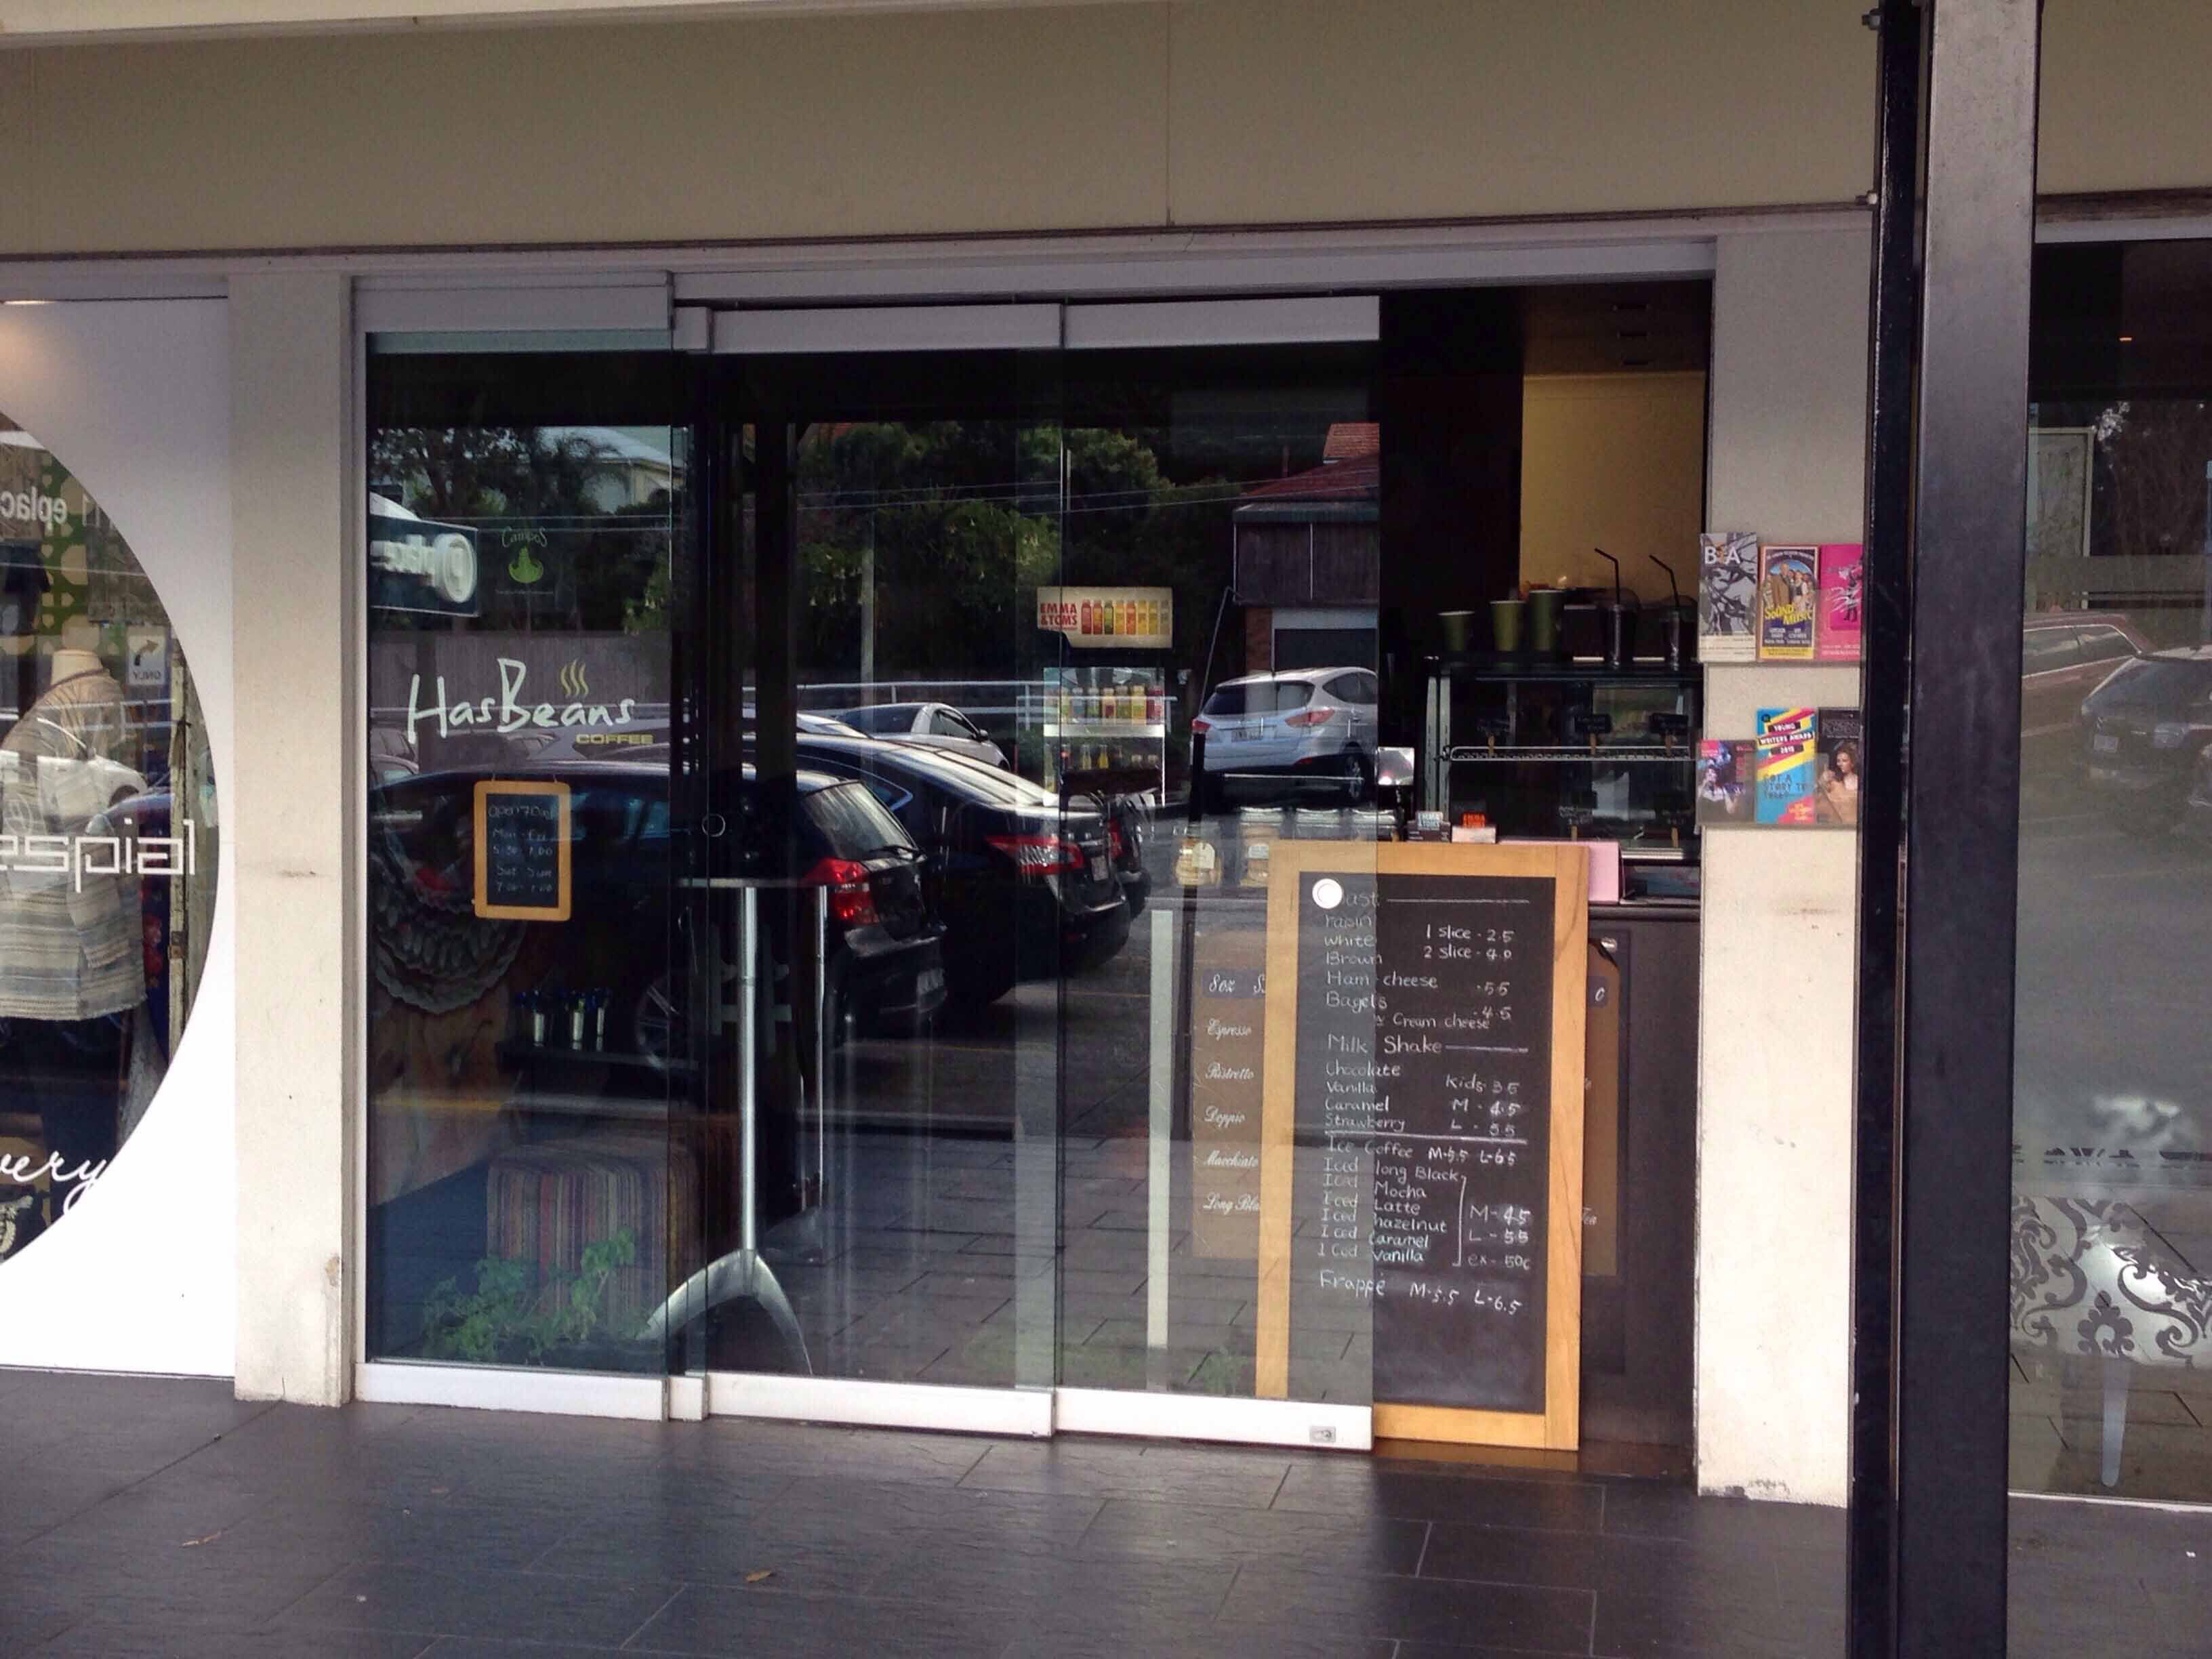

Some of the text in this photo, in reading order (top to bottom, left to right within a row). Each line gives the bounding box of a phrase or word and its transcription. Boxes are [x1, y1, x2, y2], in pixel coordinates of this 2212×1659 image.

[1040, 602, 1077, 613] EMMA
[575, 733, 654, 744] COFFEE
[1438, 924, 1472, 940] slice
[1424, 945, 1432, 958] 2
[1439, 943, 1472, 959] slice
[1382, 970, 1439, 989] cheese
[1326, 990, 1388, 1013] Bagels
[1393, 1012, 1437, 1028] Cream
[1444, 1011, 1490, 1029] cheese
[1328, 1033, 1443, 1054] Milk Shake
[1325, 1057, 1401, 1076] Chocolate
[1326, 1081, 1378, 1094] Vanilla
[1446, 1072, 1484, 1093] Kids
[1324, 1095, 1390, 1112] Caramel
[1452, 1098, 1469, 1112] M
[1324, 1113, 1406, 1133] Strawberry
[1451, 1119, 1463, 1130] L
[1364, 1139, 1414, 1159] Coffee
[1374, 1160, 1408, 1185] long
[1415, 1166, 1459, 1183] Black
[1374, 1180, 1428, 1200] Mocha
[1374, 1199, 1422, 1216] Latte
[1374, 1212, 1448, 1233] hazelnut
[1368, 1230, 1429, 1248] Caramel
